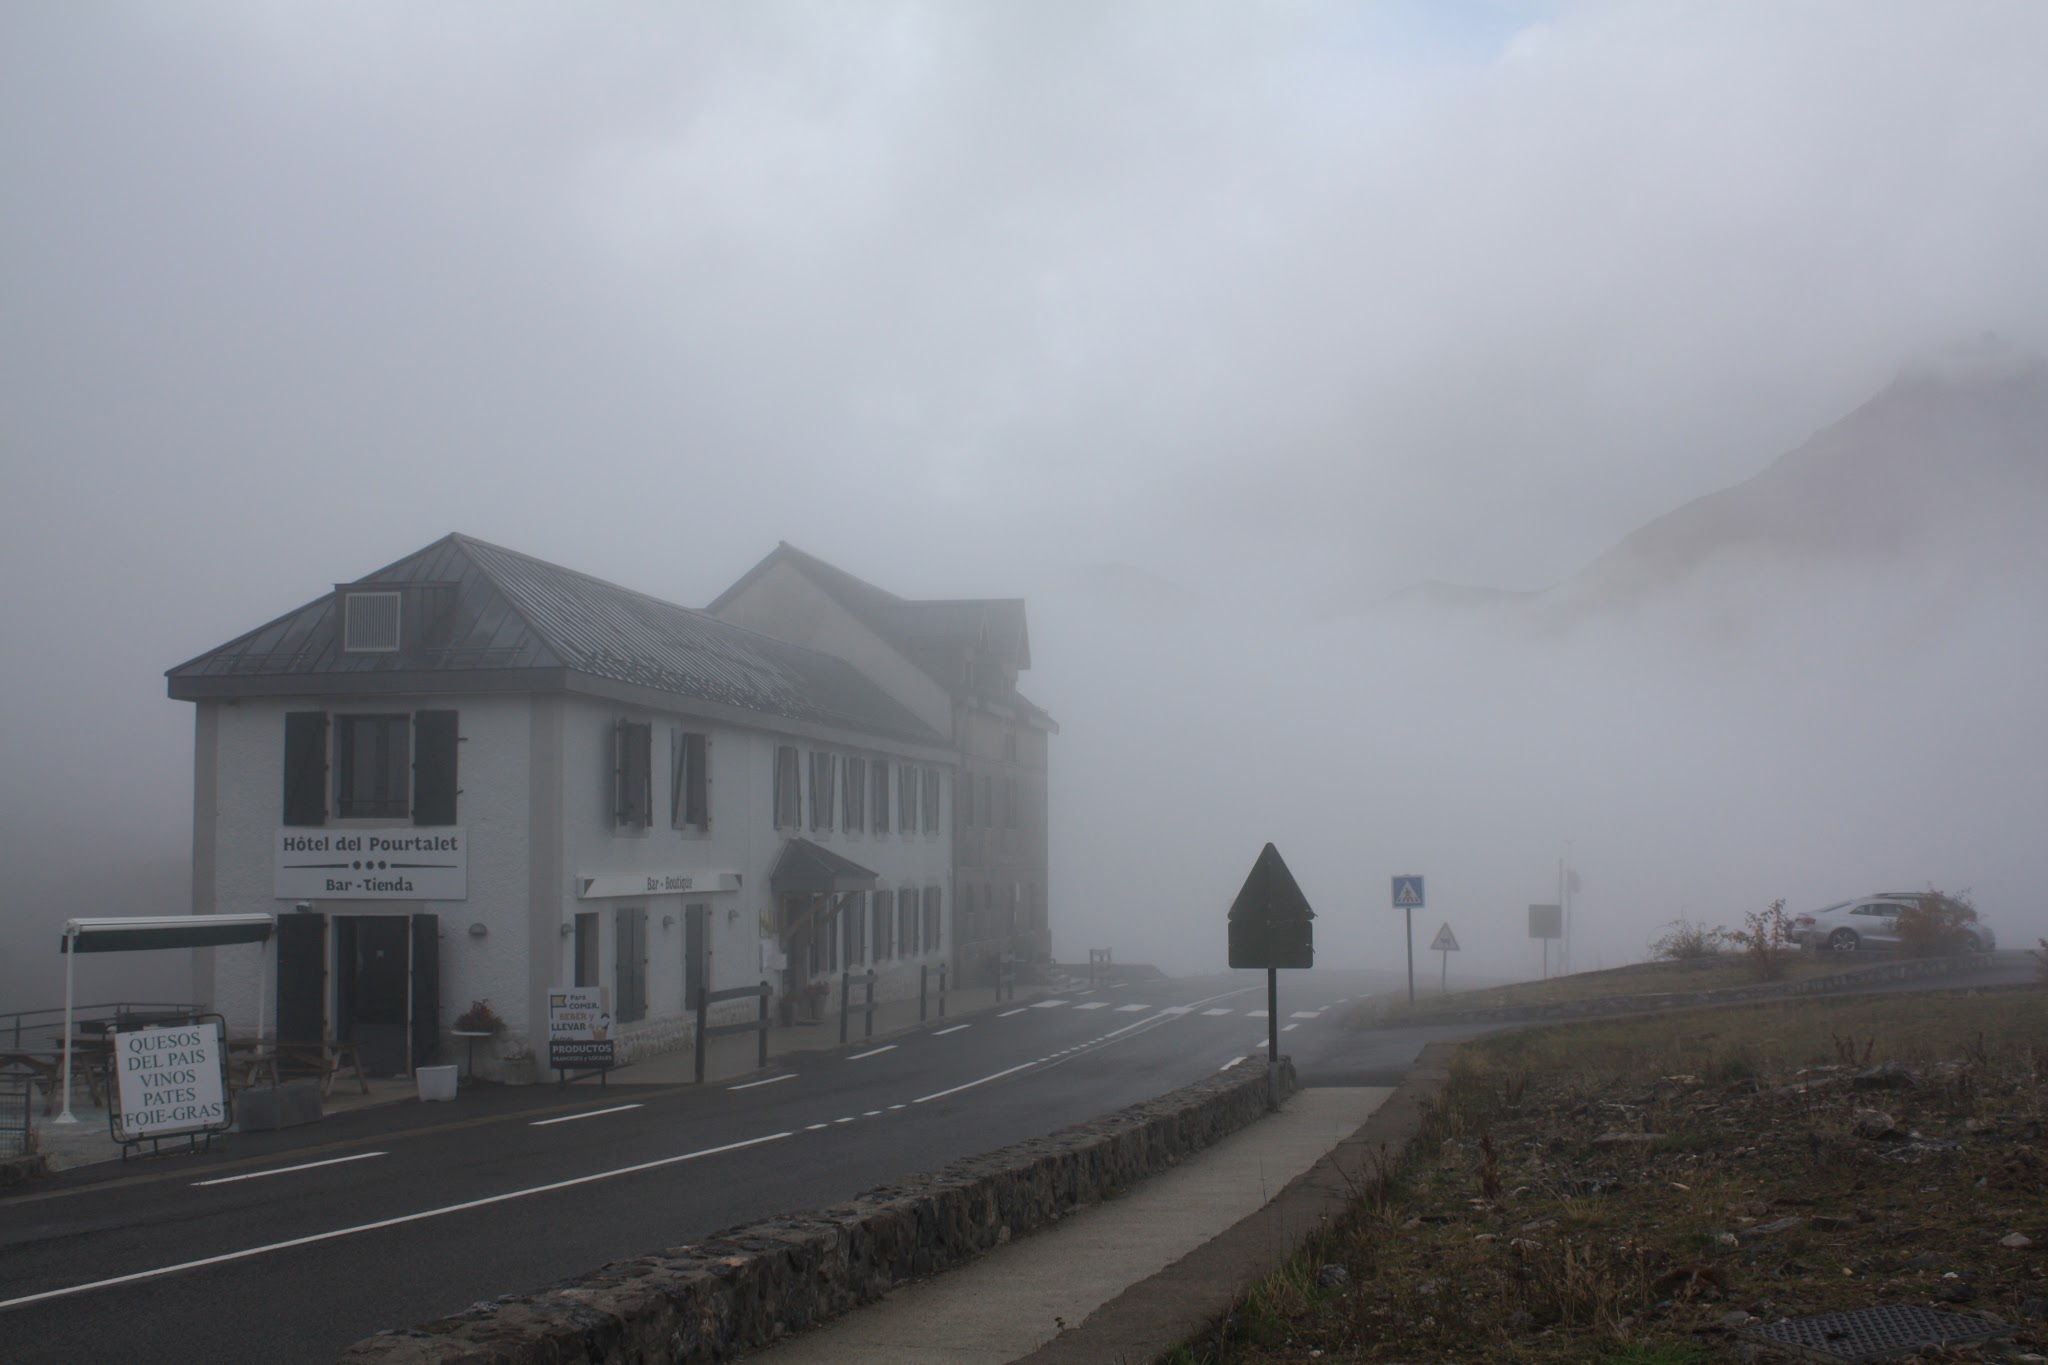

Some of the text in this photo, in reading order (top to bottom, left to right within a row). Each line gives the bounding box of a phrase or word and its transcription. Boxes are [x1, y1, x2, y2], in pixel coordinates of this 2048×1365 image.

[283, 836, 458, 852] Hôtel del Pourtalet
[326, 878, 352, 891] Bar
[647, 877, 659, 890] Bar
[665, 876, 693, 891] Boutique
[559, 1012, 587, 1021] BEBER
[551, 1023, 586, 1031] LLEVAR
[129, 1032, 201, 1054] QUESOS
[552, 1044, 612, 1053] PRODUCTOS
[128, 1049, 206, 1071] DEL PAIS
[140, 1069, 196, 1087] VINOS
[143, 1088, 196, 1106] PATES
[124, 1103, 221, 1127] FOIE-GRAS
